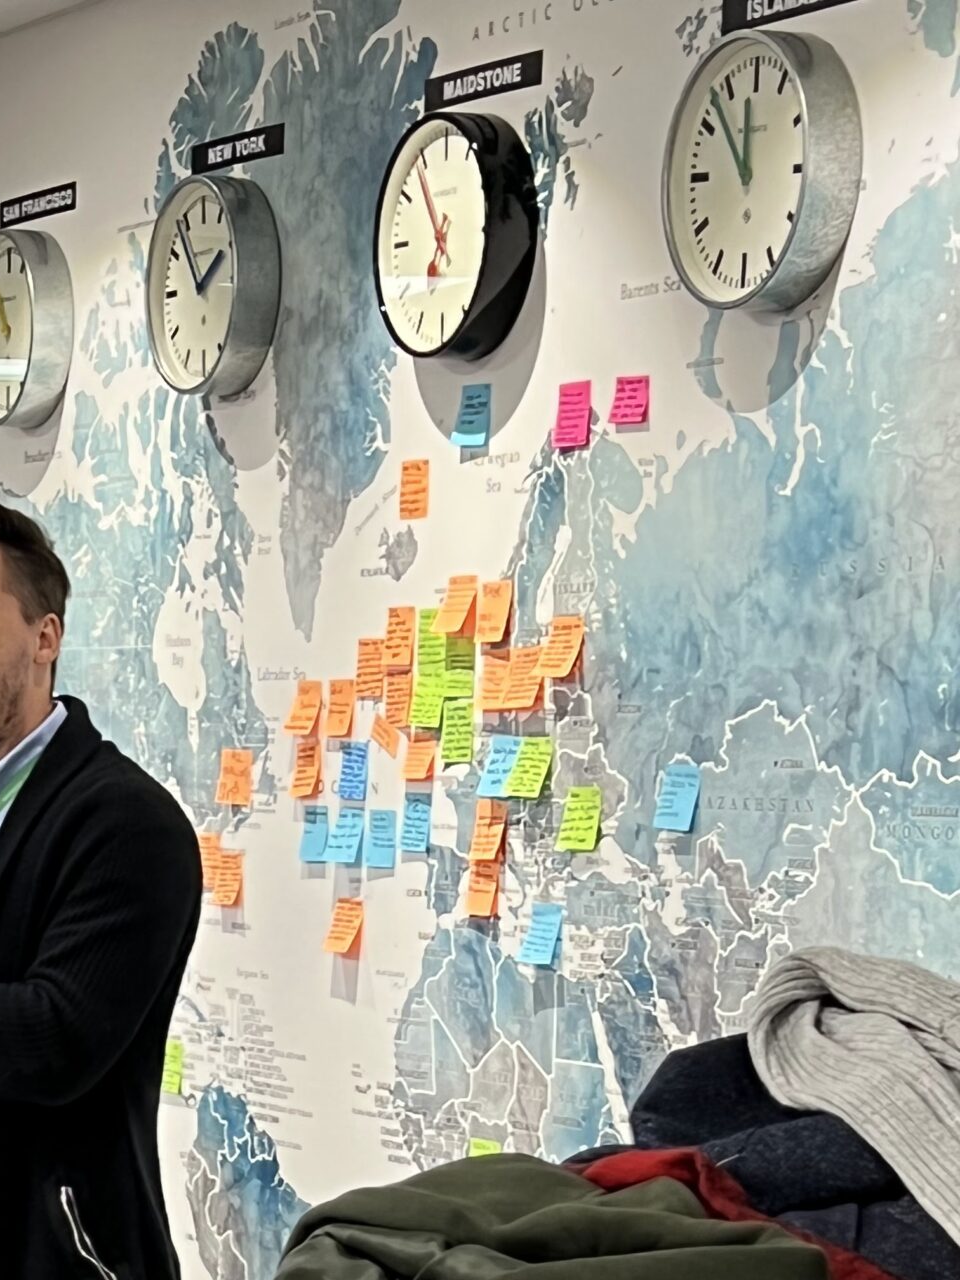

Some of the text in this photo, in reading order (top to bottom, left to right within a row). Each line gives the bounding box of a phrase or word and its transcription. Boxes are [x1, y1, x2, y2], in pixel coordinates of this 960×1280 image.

[472, 2, 552, 41] ARCTIC
[443, 63, 522, 100] MAIDSTONE
[207, 134, 266, 164] NEW YORK
[2, 189, 73, 222] SAN FRANCISCO
[705, 796, 814, 812] AZAKHSTAN
